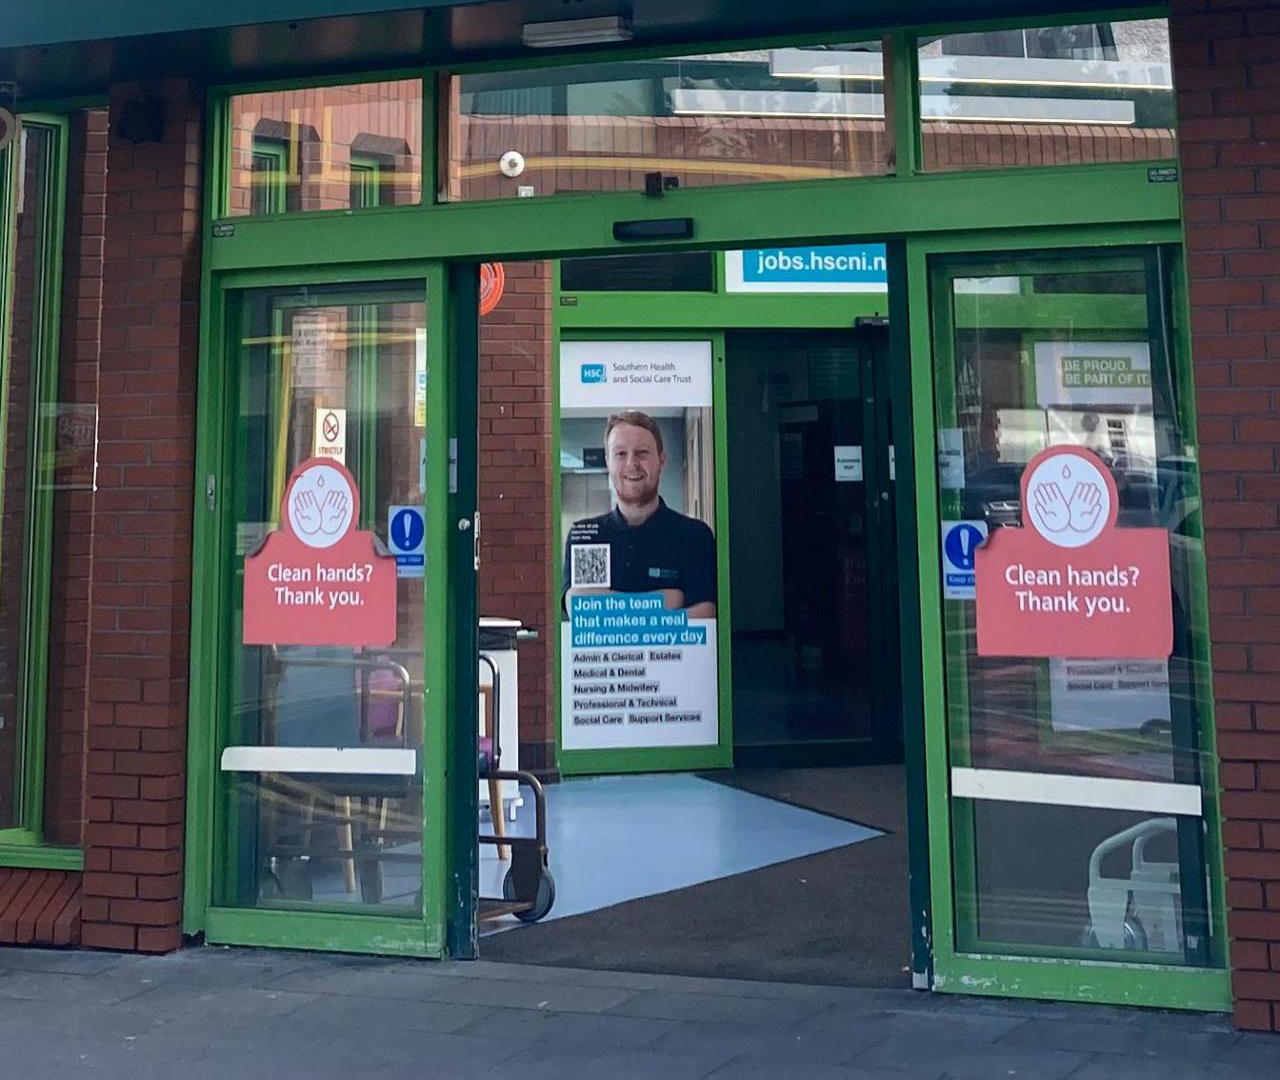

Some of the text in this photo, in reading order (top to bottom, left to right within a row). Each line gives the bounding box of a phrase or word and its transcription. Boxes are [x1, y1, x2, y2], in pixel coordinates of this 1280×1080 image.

[756, 250, 887, 274] jobs.hscni.n
[613, 362, 676, 372] Southern Health
[1064, 360, 1081, 371] BE
[584, 369, 602, 378] HSC
[613, 374, 692, 383] and Social Care Trust
[1066, 373, 1081, 384] BE
[1085, 373, 1115, 384] PART
[1118, 373, 1134, 384] OF
[267, 563, 373, 583] Clean hands?
[1005, 564, 1140, 587] Clean hands?
[275, 587, 365, 610] Thank you.
[574, 597, 662, 611] Join the team
[1015, 590, 1131, 618] Thank you.
[575, 612, 686, 628] that makes a real
[574, 629, 704, 646] difference every day
[573, 652, 644, 663] Admin & Clerical
[650, 652, 682, 661] Estates
[574, 668, 608, 678] Medical
[618, 667, 646, 677] Dental
[574, 683, 659, 695] Nursing & Midwifery
[574, 700, 627, 710] Professional
[638, 698, 677, 708] Technical
[574, 715, 623, 725] Social Care
[629, 712, 701, 724] Support Services
